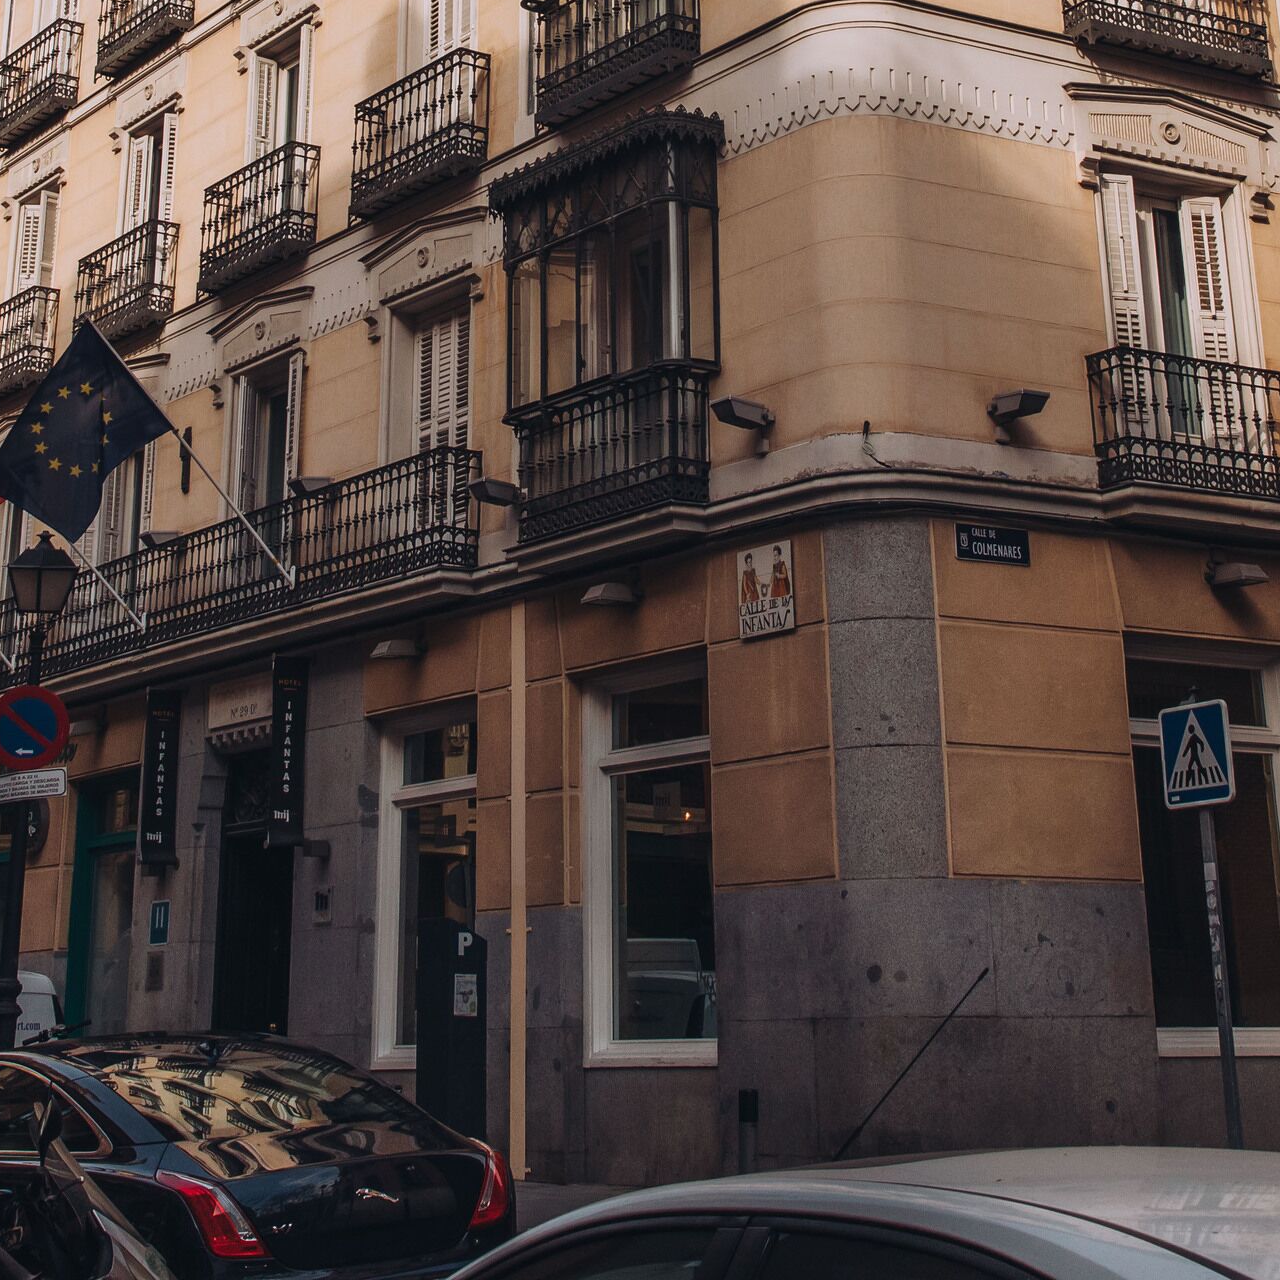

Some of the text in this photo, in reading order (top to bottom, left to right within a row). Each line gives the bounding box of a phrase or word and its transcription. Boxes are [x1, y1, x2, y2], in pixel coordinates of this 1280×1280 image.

[971, 527, 996, 539] CALLE DE
[972, 541, 1022, 560] COLMENARES
[739, 599, 768, 617] CALLE
[768, 597, 779, 610] DE
[741, 609, 790, 634] INFANTAS
[278, 678, 302, 687] HOTEL
[283, 700, 293, 793] INFANTAS
[155, 730, 166, 816] INFANTAS
[458, 932, 473, 956] P
